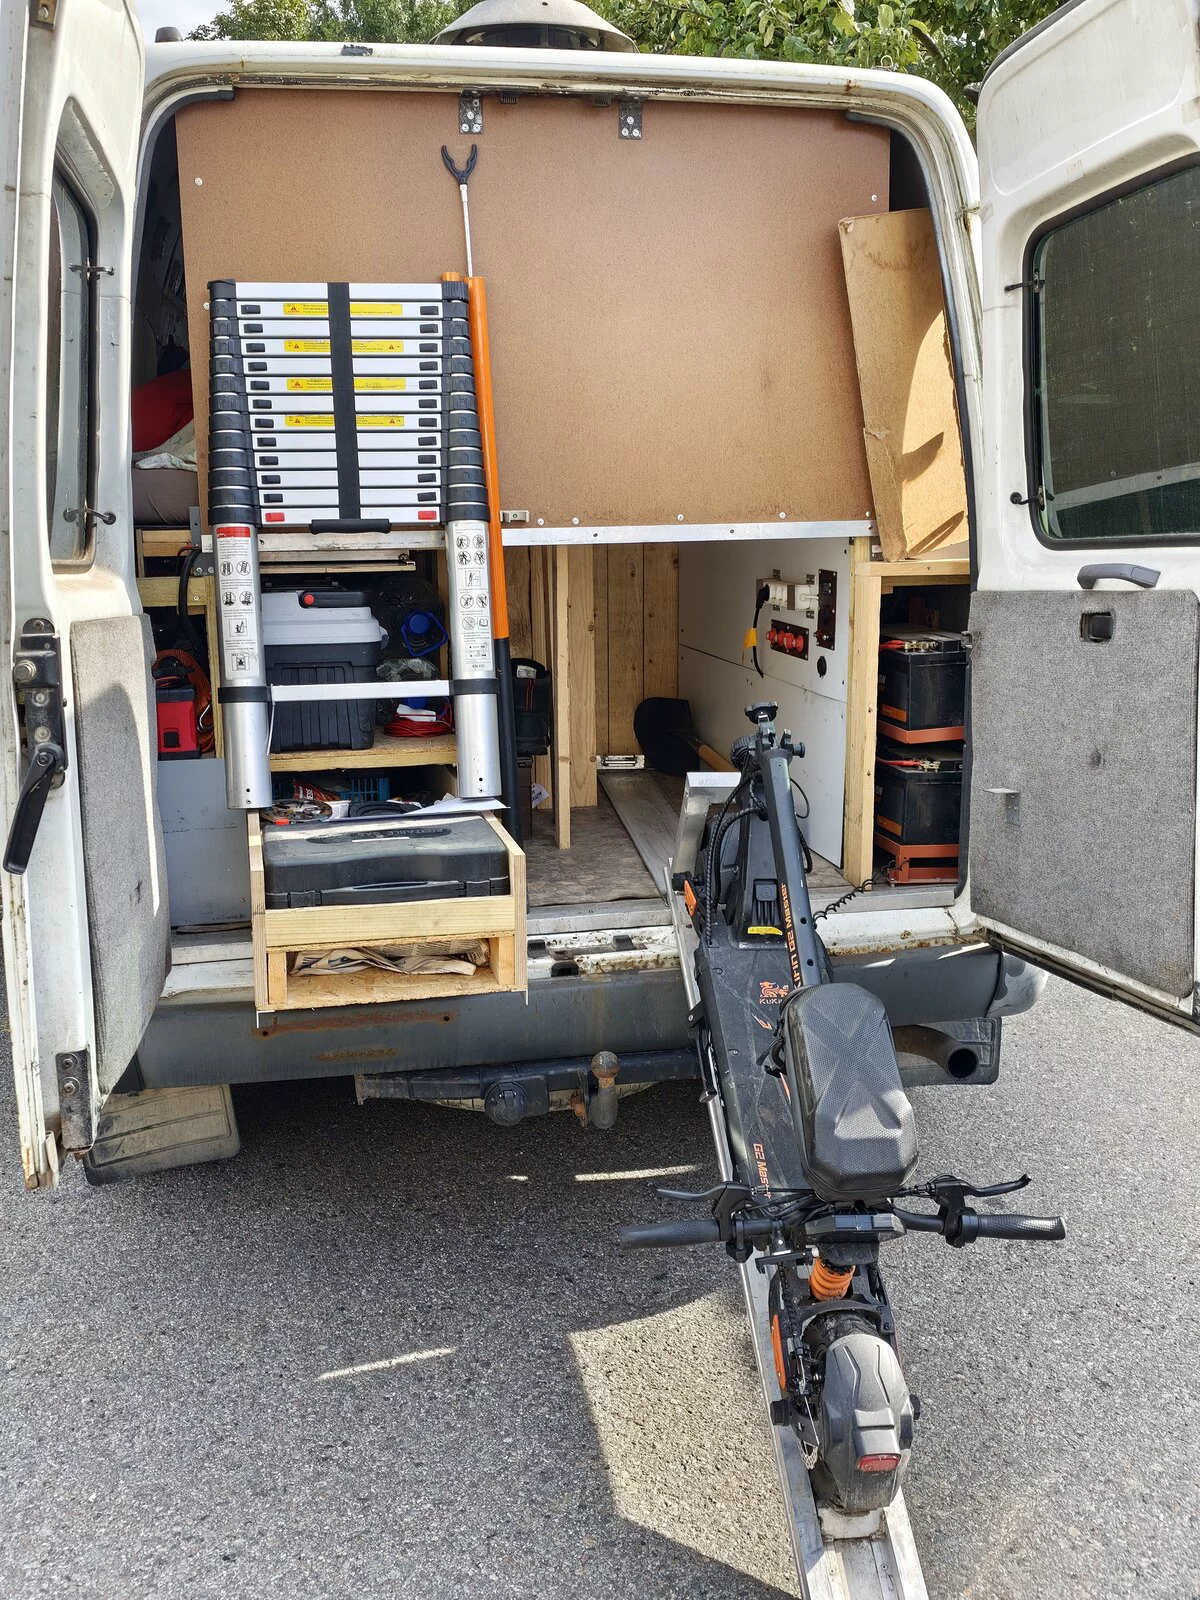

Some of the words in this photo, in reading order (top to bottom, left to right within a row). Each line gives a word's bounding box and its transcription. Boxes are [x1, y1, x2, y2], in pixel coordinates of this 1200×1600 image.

[780, 883, 792, 929] Master
[787, 930, 796, 953] G2
[753, 1143, 766, 1160] G2
